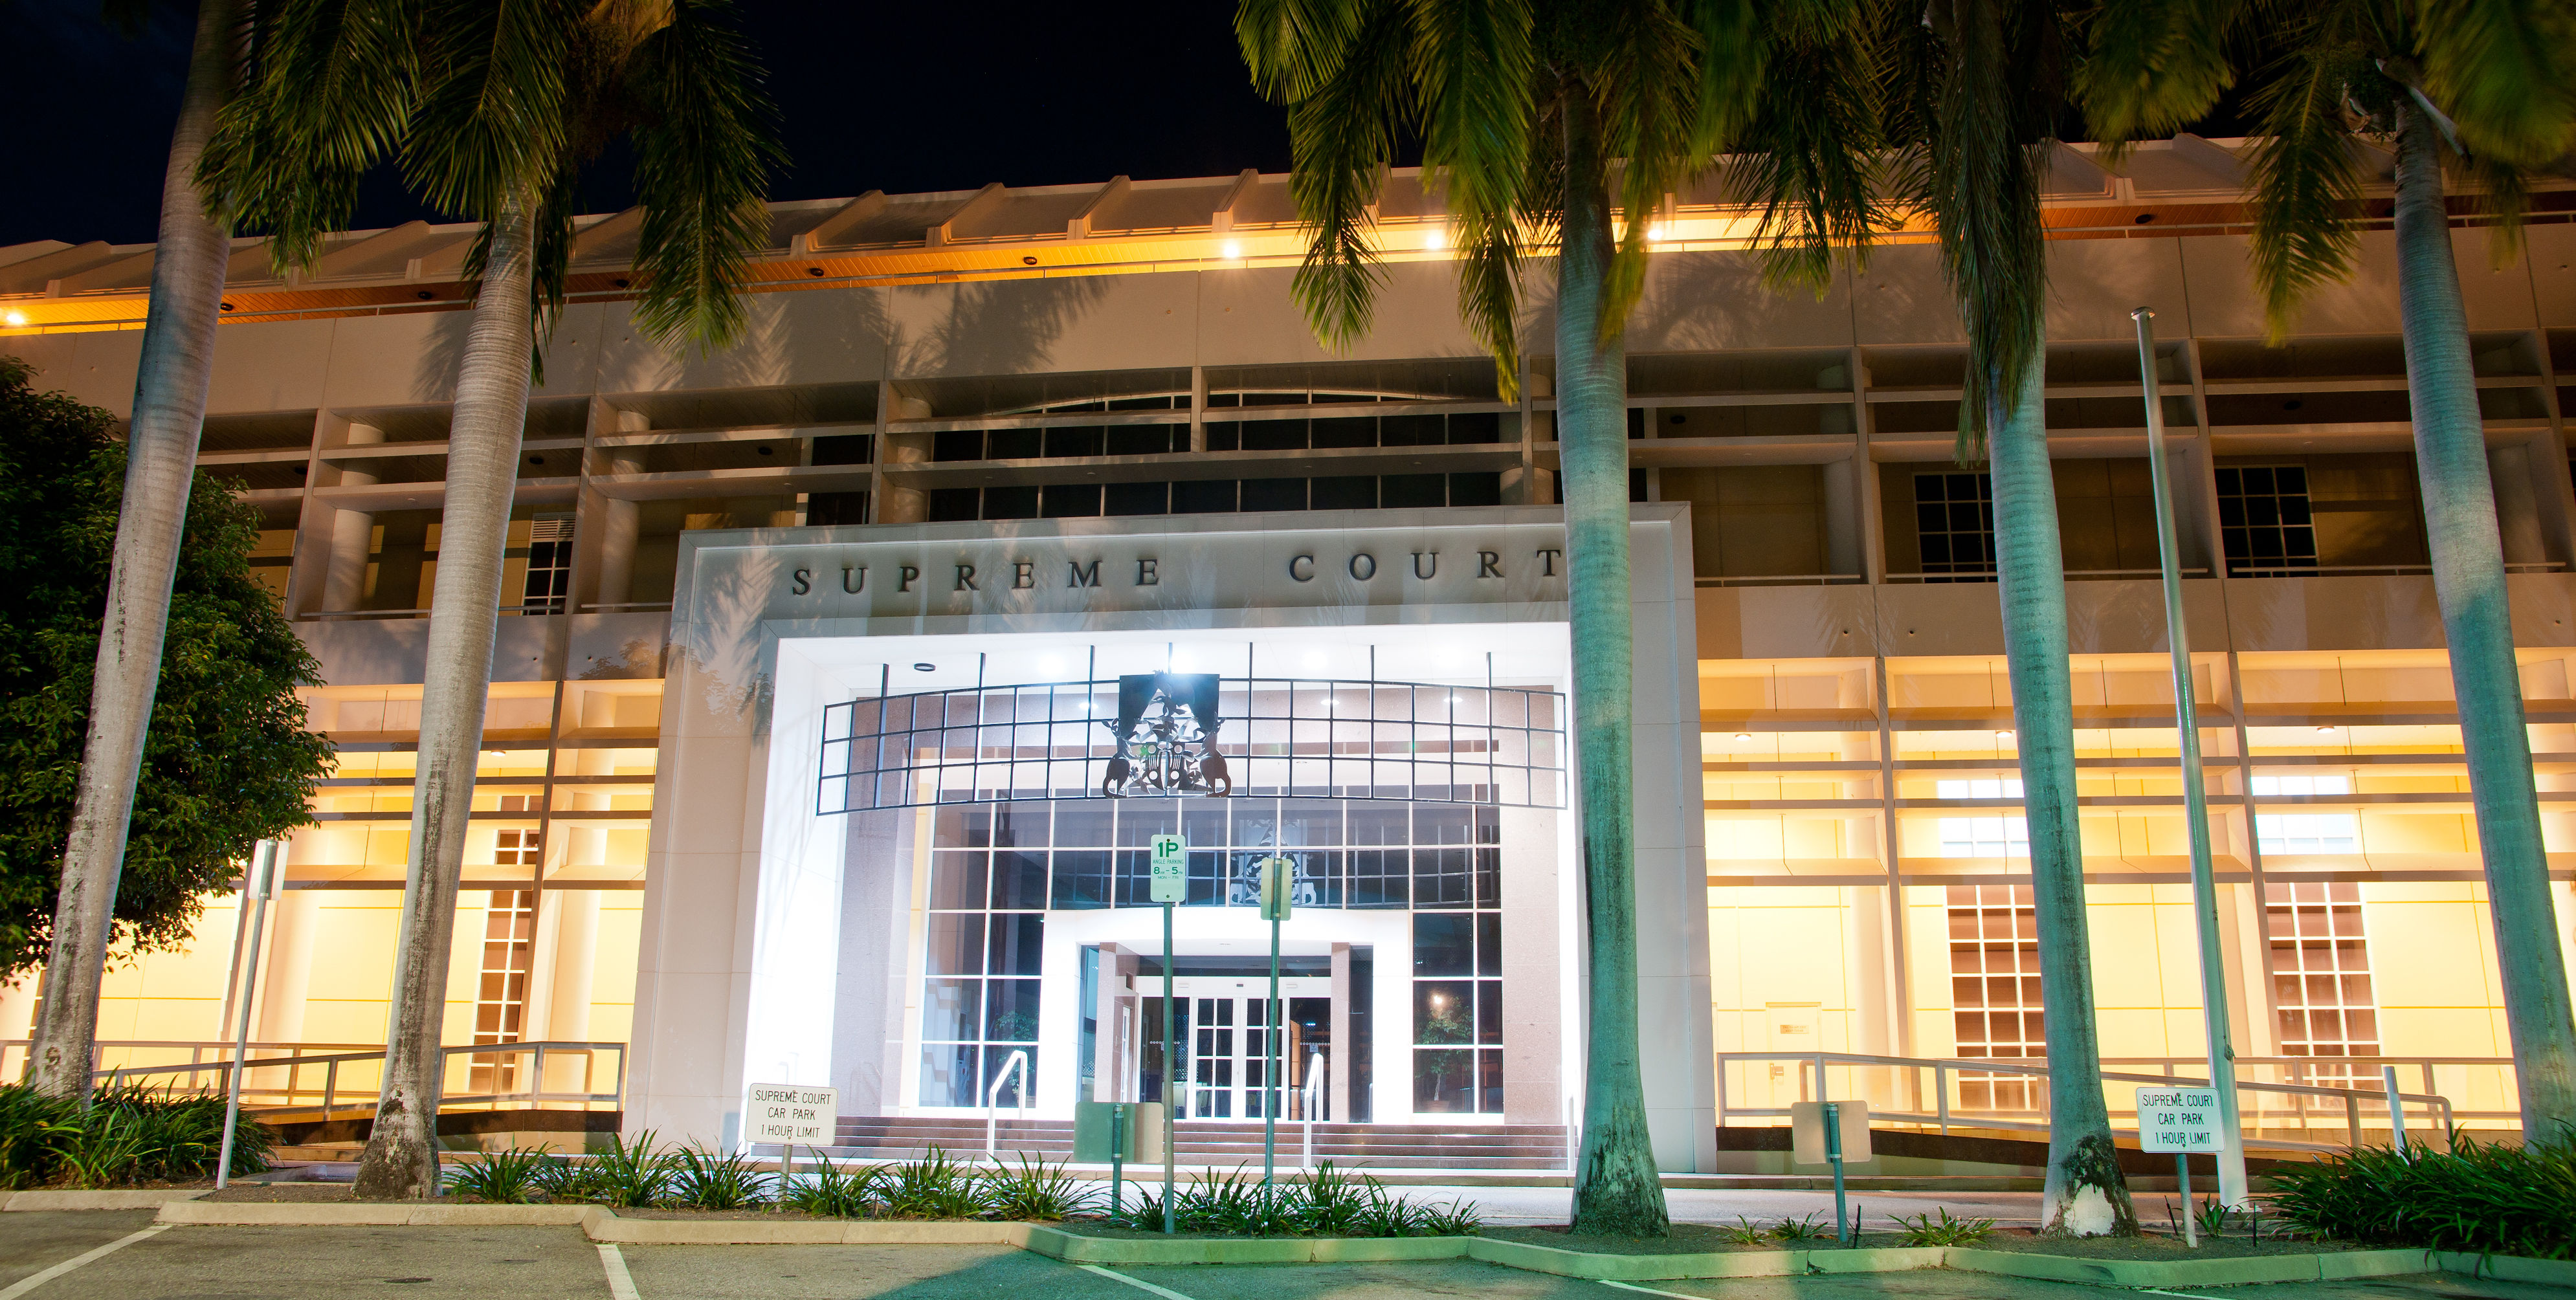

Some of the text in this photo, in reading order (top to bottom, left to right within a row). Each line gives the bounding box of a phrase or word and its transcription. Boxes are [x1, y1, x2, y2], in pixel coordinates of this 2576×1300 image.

[792, 549, 1561, 596] SUPREME COURT
[1158, 842, 1179, 857] 1P
[755, 1090, 832, 1105] SUPREME COURT
[2142, 1094, 2214, 1107] SUPREME COURT
[768, 1107, 816, 1120] CAR PARK
[2158, 1113, 2204, 1125] CAR PARK
[761, 1124, 821, 1138] 1 HOUR LIMIT
[2155, 1132, 2211, 1145] 1 HOUR LIMIT
